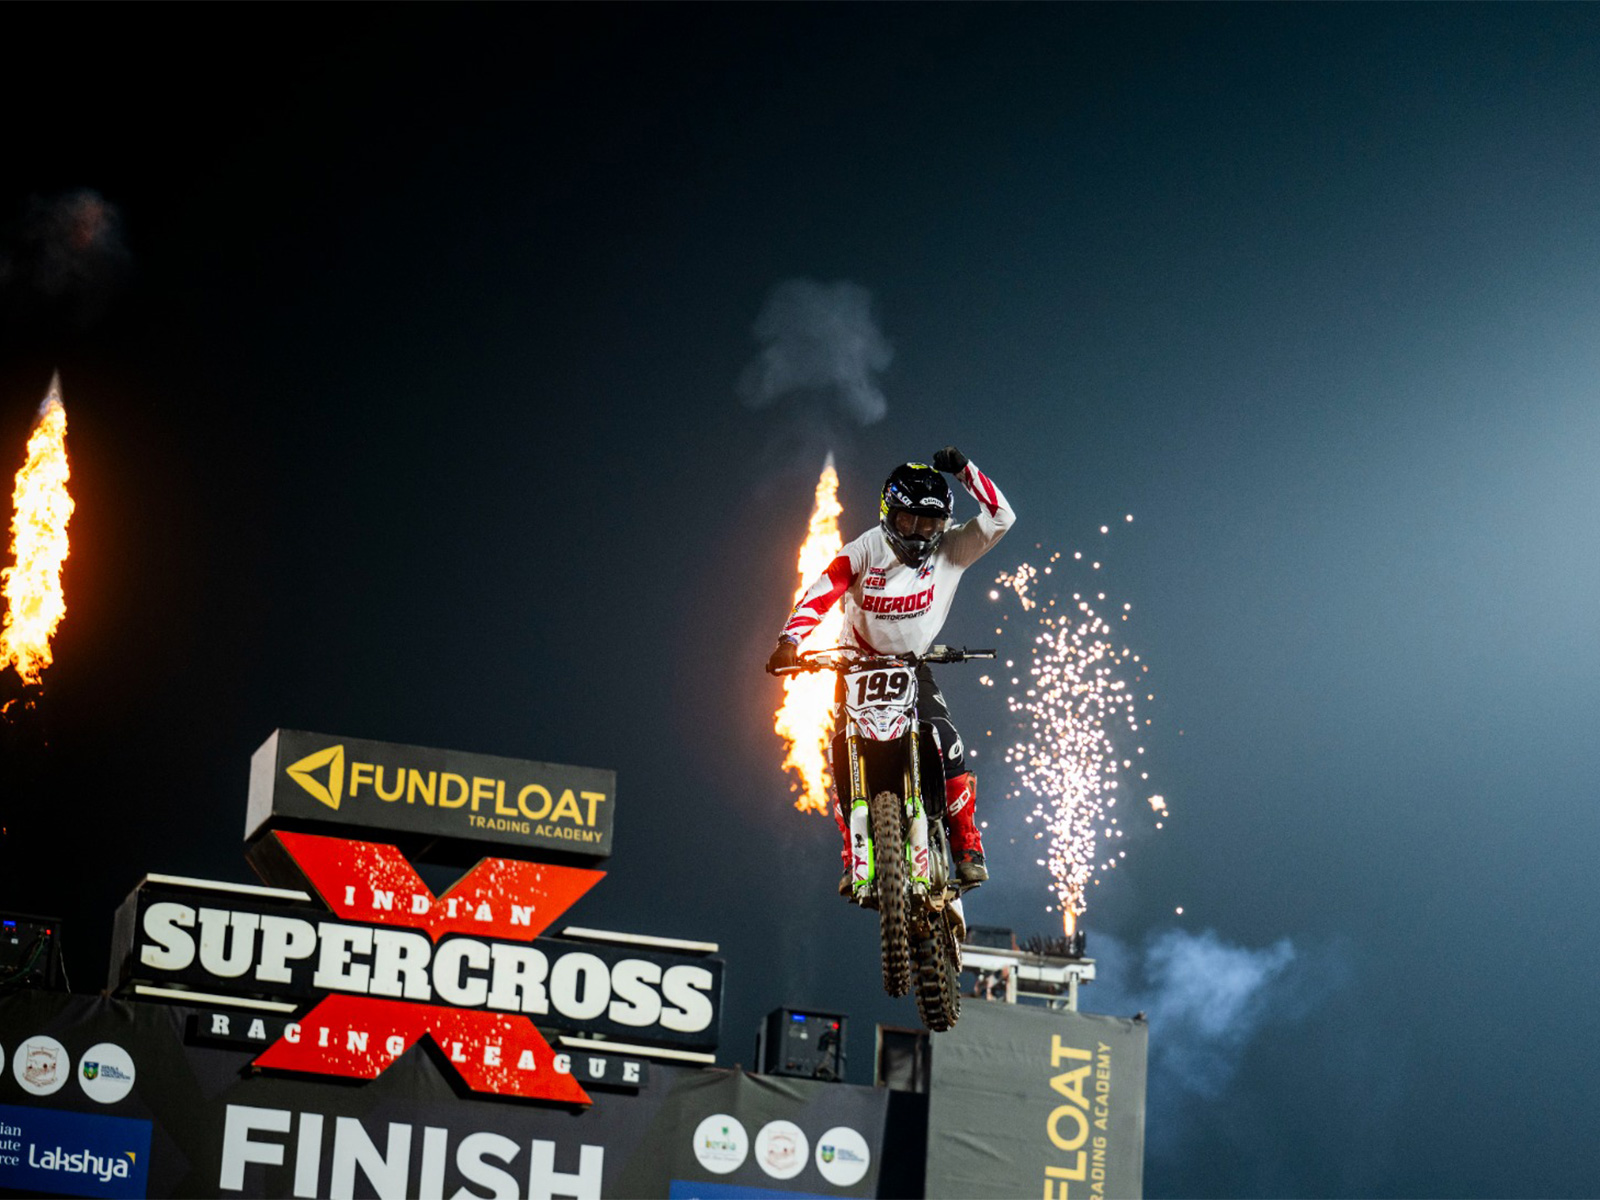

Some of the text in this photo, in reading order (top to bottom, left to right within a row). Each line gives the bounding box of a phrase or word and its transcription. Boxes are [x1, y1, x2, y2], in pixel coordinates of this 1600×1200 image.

[862, 584, 935, 613] BIGROCK
[875, 610, 925, 621] MOTORSPORTS
[856, 671, 909, 705] 199
[349, 762, 606, 827] FUNDFLOAT
[468, 814, 603, 844] TRADING ACADEMY
[344, 885, 535, 926] INDIAN
[141, 902, 714, 1033] SUPERCROSS
[210, 1013, 640, 1083] RACING LEAGUE
[1094, 1041, 1112, 1131] ACADEMY
[28, 1143, 129, 1182] Lakshya
[219, 1103, 605, 1200] FINISH
